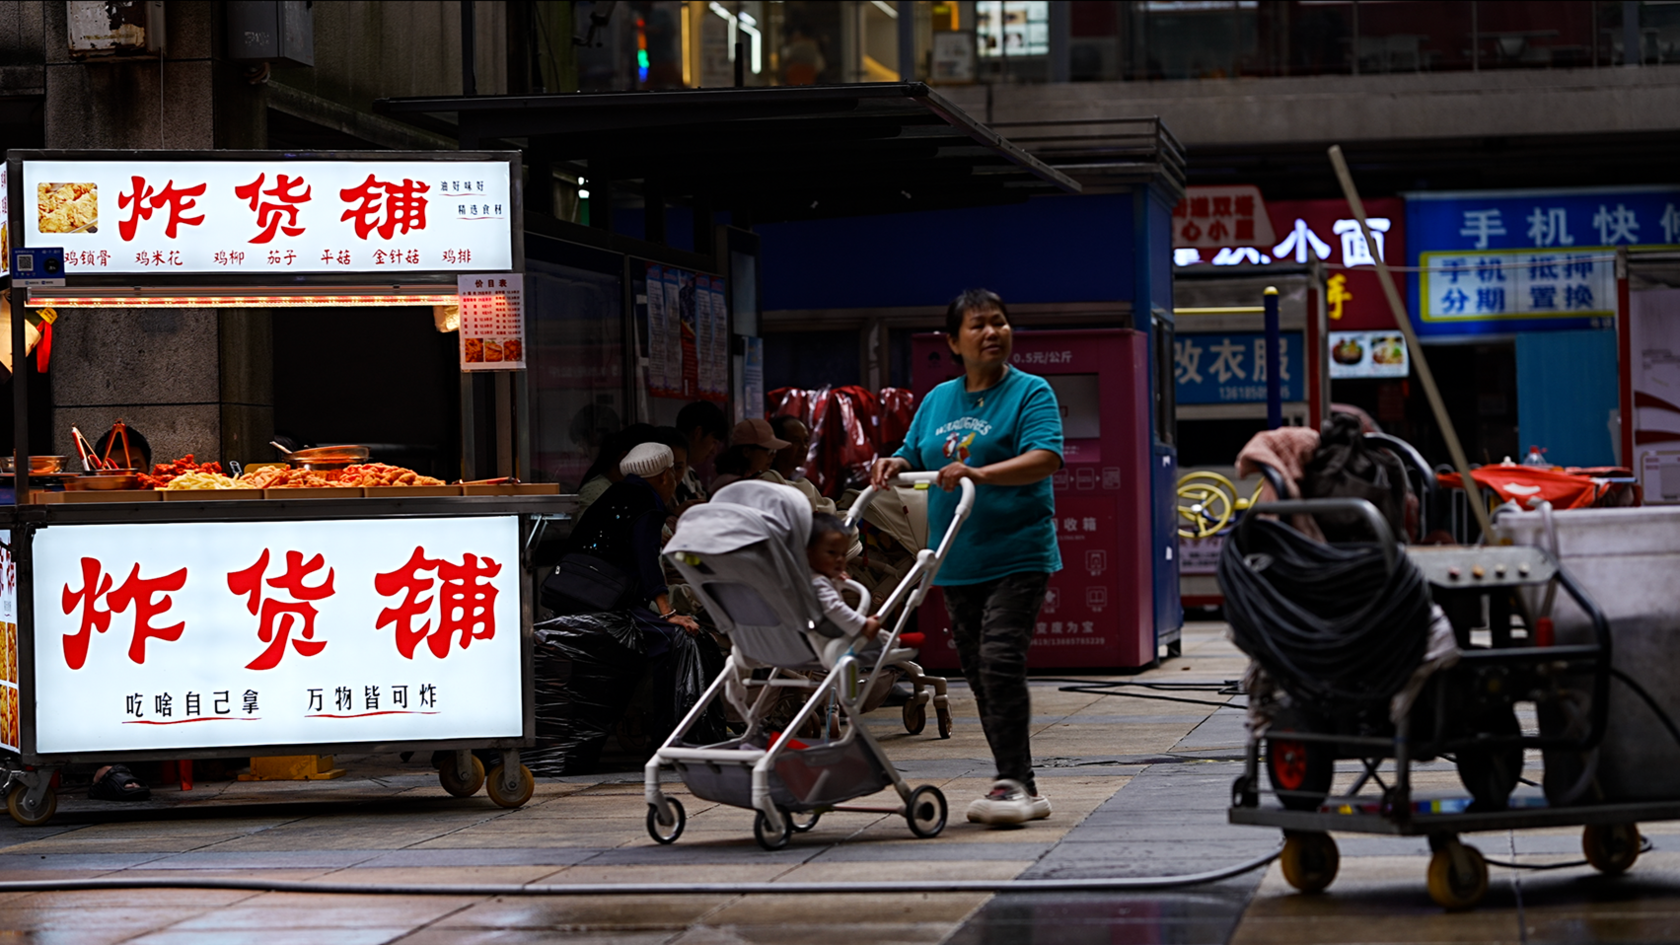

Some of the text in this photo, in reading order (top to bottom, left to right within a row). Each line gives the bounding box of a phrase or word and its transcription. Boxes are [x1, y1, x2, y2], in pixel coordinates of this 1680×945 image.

[441, 181, 484, 191] 油好味好
[118, 173, 430, 244] 炸货铺
[458, 204, 502, 215] 精选食材
[65, 248, 472, 266] 鸡锁骨 鸡米花 鸡柳 茄子 平菇 金针菇 鸡排
[1439, 254, 1594, 284] 手机 抵押
[475, 279, 507, 288] 价目表
[1441, 284, 1594, 314] 分期 置换
[1174, 337, 1292, 385] 改衣服
[62, 546, 502, 671] 炸货铺
[126, 683, 437, 718] 吃啥自己拿 万物皆可炸
